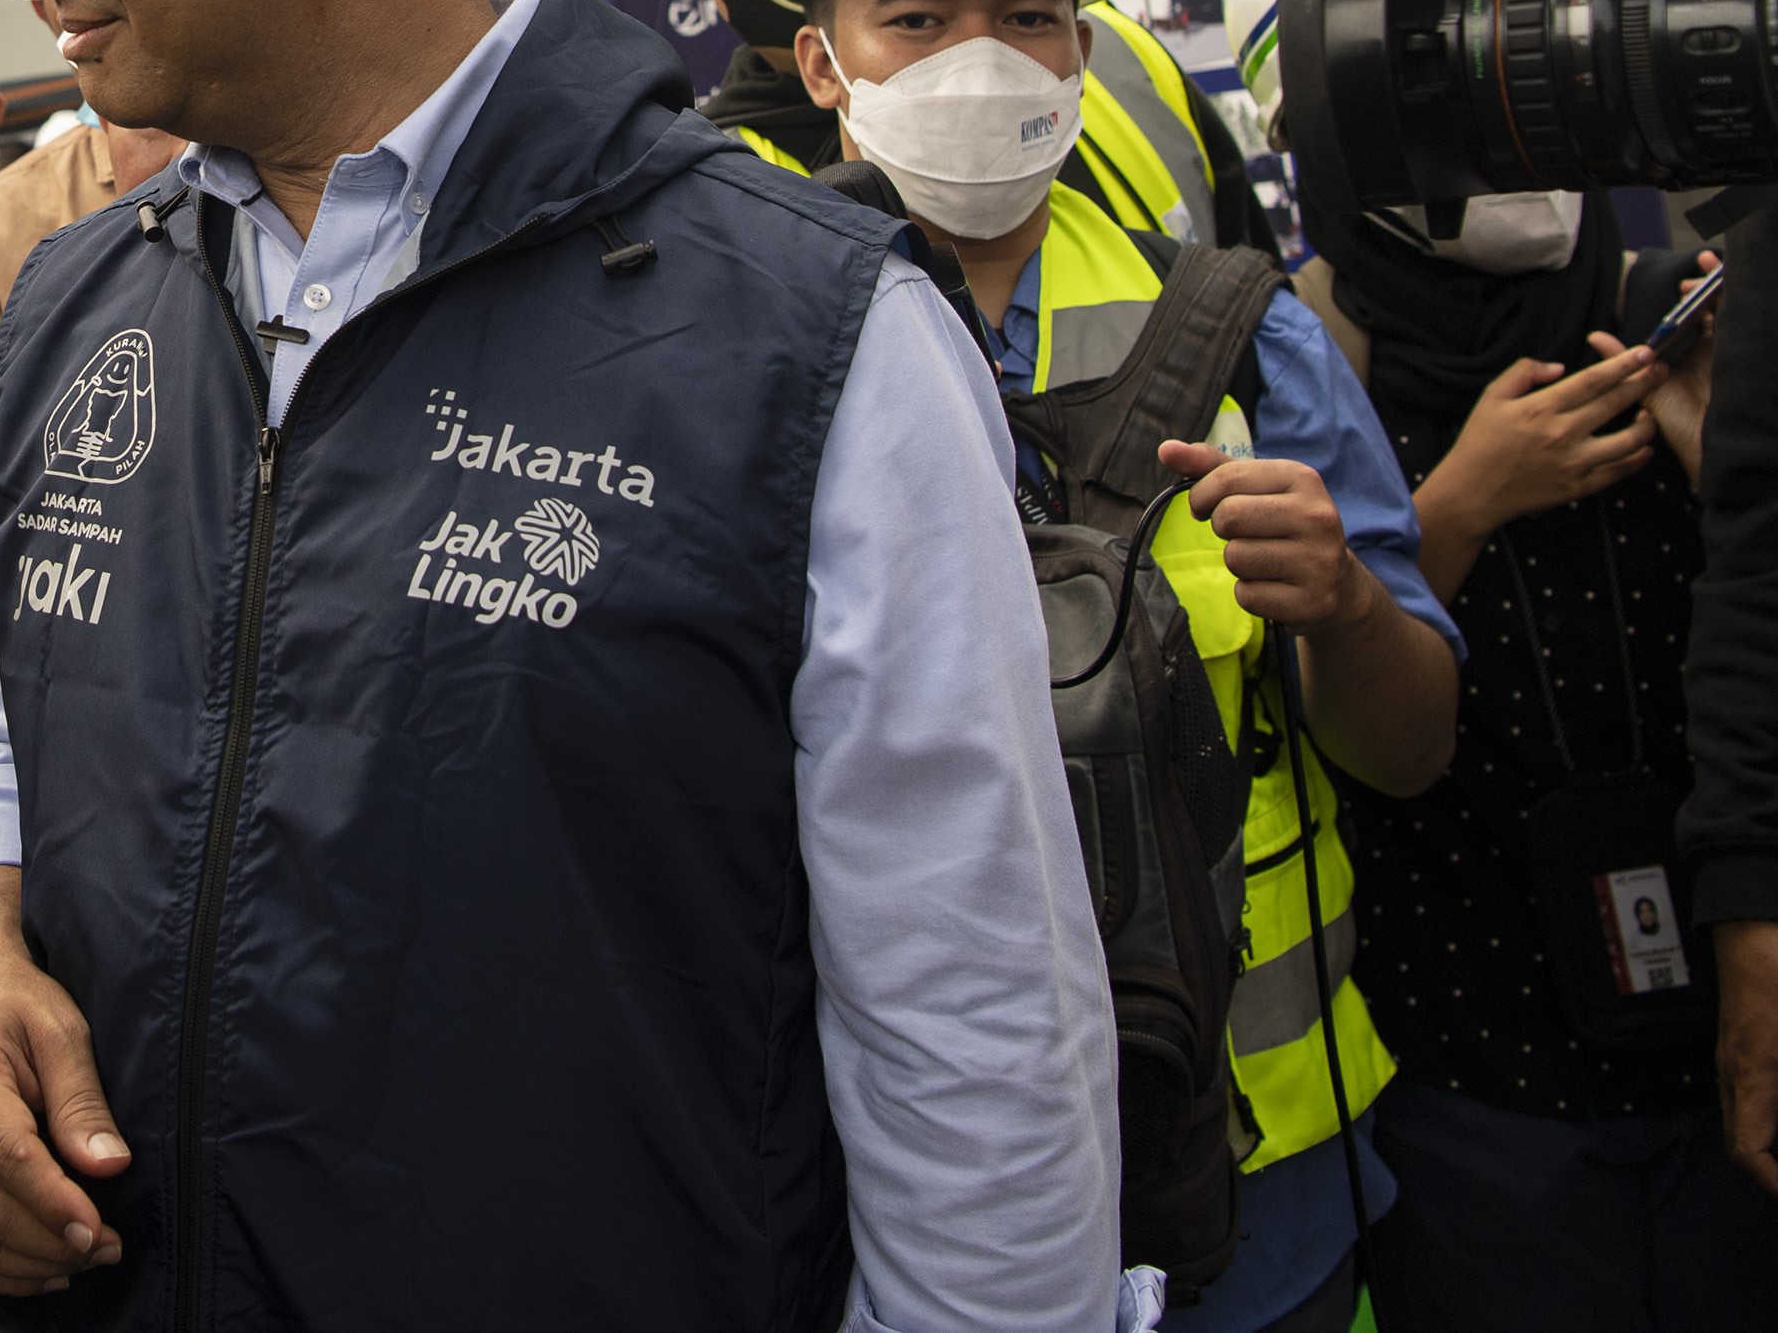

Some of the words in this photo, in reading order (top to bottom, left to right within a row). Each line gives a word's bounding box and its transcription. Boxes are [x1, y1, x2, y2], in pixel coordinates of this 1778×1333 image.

[115, 439, 146, 475] PILAH
[40, 491, 103, 517] JAKARTA
[17, 512, 58, 533] SADAR
[58, 517, 123, 545] SAMPAH
[419, 510, 513, 564] Jak
[407, 553, 579, 630] Lingko
